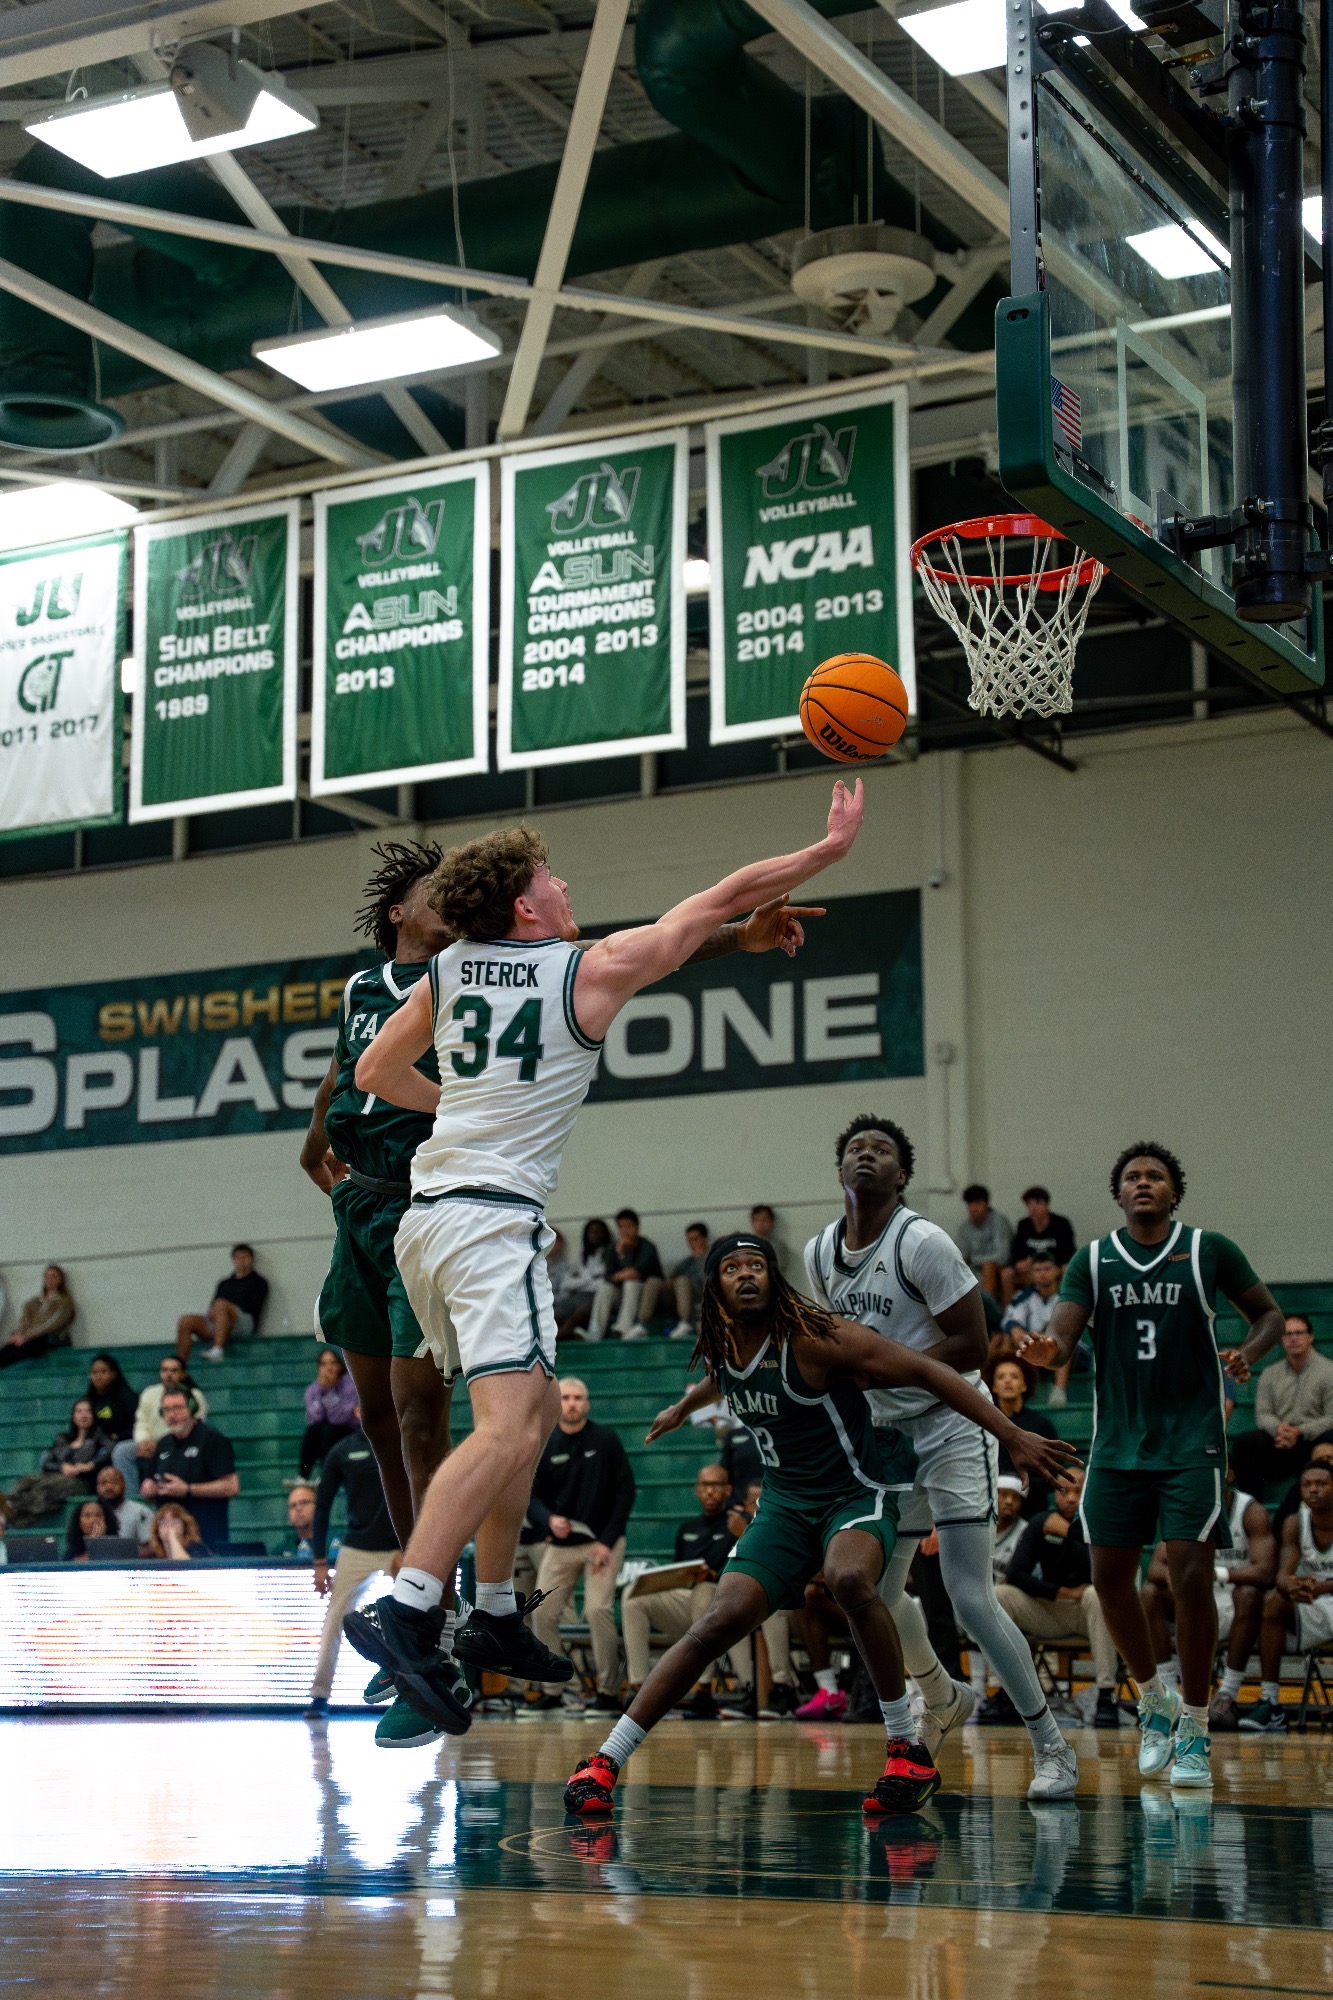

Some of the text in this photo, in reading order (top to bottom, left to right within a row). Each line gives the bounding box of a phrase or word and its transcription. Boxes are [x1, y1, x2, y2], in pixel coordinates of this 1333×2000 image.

[759, 492, 857, 523] VOLLEYBALL
[548, 530, 637, 557] VOLLEYBALL
[742, 525, 874, 588] NCAA
[357, 562, 441, 589] VOLLEYBALL
[529, 544, 655, 594] ASUN
[176, 596, 254, 621] VOLLEYBALL
[343, 586, 457, 635] ASUN
[527, 579, 656, 614] TOURNAMENT
[736, 589, 884, 635] 2004 2013
[527, 598, 655, 635] CHAMPIONS
[335, 620, 463, 659] CHAMPIONS
[523, 624, 658, 664] 2004 2013
[737, 631, 804, 662] 2014
[154, 650, 274, 687] CHAMPIONS
[335, 666, 395, 694] 2013
[522, 663, 585, 691] 2014
[155, 694, 209, 721] 1989
[50, 714, 100, 739] 2017
[461, 961, 539, 987] STERCK
[0, 972, 882, 1137] SPLAS ONE
[451, 995, 544, 1083] 34
[834, 1292, 893, 1317] OLPHINS
[1109, 1282, 1182, 1308] FAMU
[1136, 1319, 1157, 1361] 3
